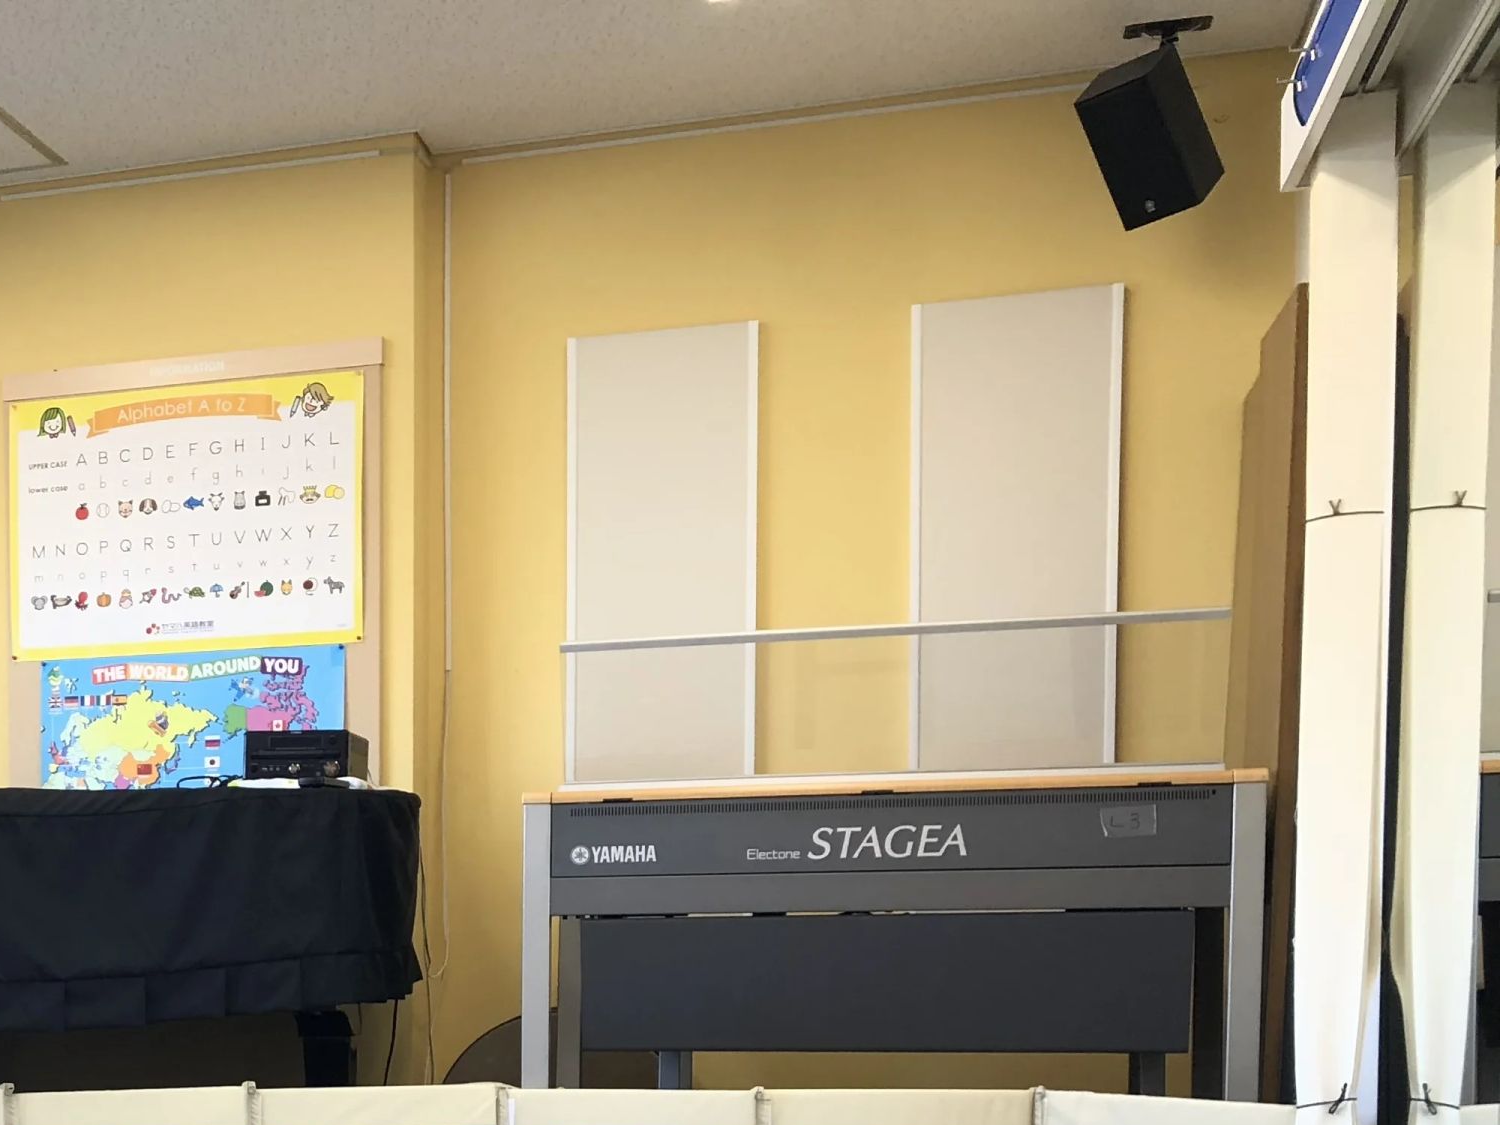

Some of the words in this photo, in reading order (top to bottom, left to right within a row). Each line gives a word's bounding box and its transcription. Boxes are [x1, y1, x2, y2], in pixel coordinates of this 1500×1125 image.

[117, 400, 192, 423] Alphabet
[198, 400, 210, 412] A
[216, 399, 232, 412] to
[237, 397, 247, 412] Z
[76, 454, 87, 466] A
[99, 451, 108, 464] B
[120, 449, 130, 462] C
[143, 447, 153, 460] D
[166, 445, 175, 458] E
[189, 443, 198, 456] F
[209, 441, 222, 454] G
[235, 439, 244, 452] H
[282, 435, 290, 448] J
[305, 433, 315, 446] K
[330, 432, 339, 445] L
[51, 460, 68, 469] CASE
[51, 485, 69, 493] case
[33, 546, 45, 558] M
[56, 544, 65, 556] N
[76, 543, 88, 555] O
[100, 541, 108, 553] P
[120, 539, 132, 552] Q
[144, 537, 153, 550] R
[167, 536, 175, 549] S
[189, 534, 200, 546] T
[212, 532, 221, 545] U
[234, 530, 245, 544] V
[255, 528, 271, 542] W
[281, 527, 292, 540] X
[306, 526, 314, 538] Y
[328, 524, 338, 537] Z
[93, 667, 127, 682] THE
[127, 664, 190, 681] WORLD
[191, 656, 262, 680] AROUND
[263, 658, 301, 674] YOU
[591, 845, 657, 863] YAMAHA
[746, 848, 800, 860] Electone
[807, 824, 968, 859] STAGEA
